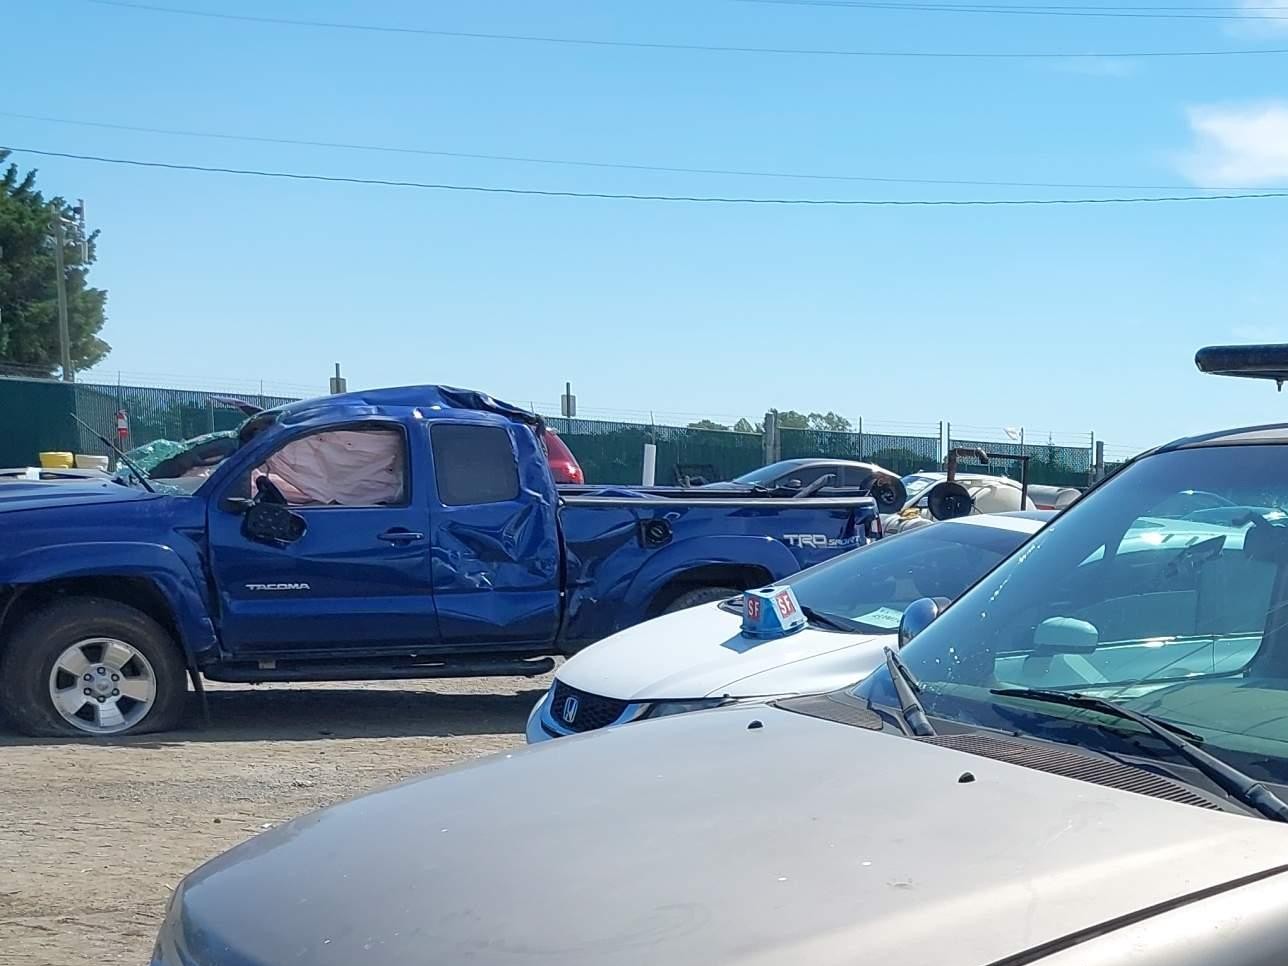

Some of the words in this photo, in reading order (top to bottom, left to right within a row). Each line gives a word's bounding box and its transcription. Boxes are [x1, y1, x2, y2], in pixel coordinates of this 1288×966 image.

[783, 534, 828, 549] TRD
[245, 583, 311, 591] TACOMA
[747, 599, 760, 618] SF
[777, 594, 795, 617] SF
